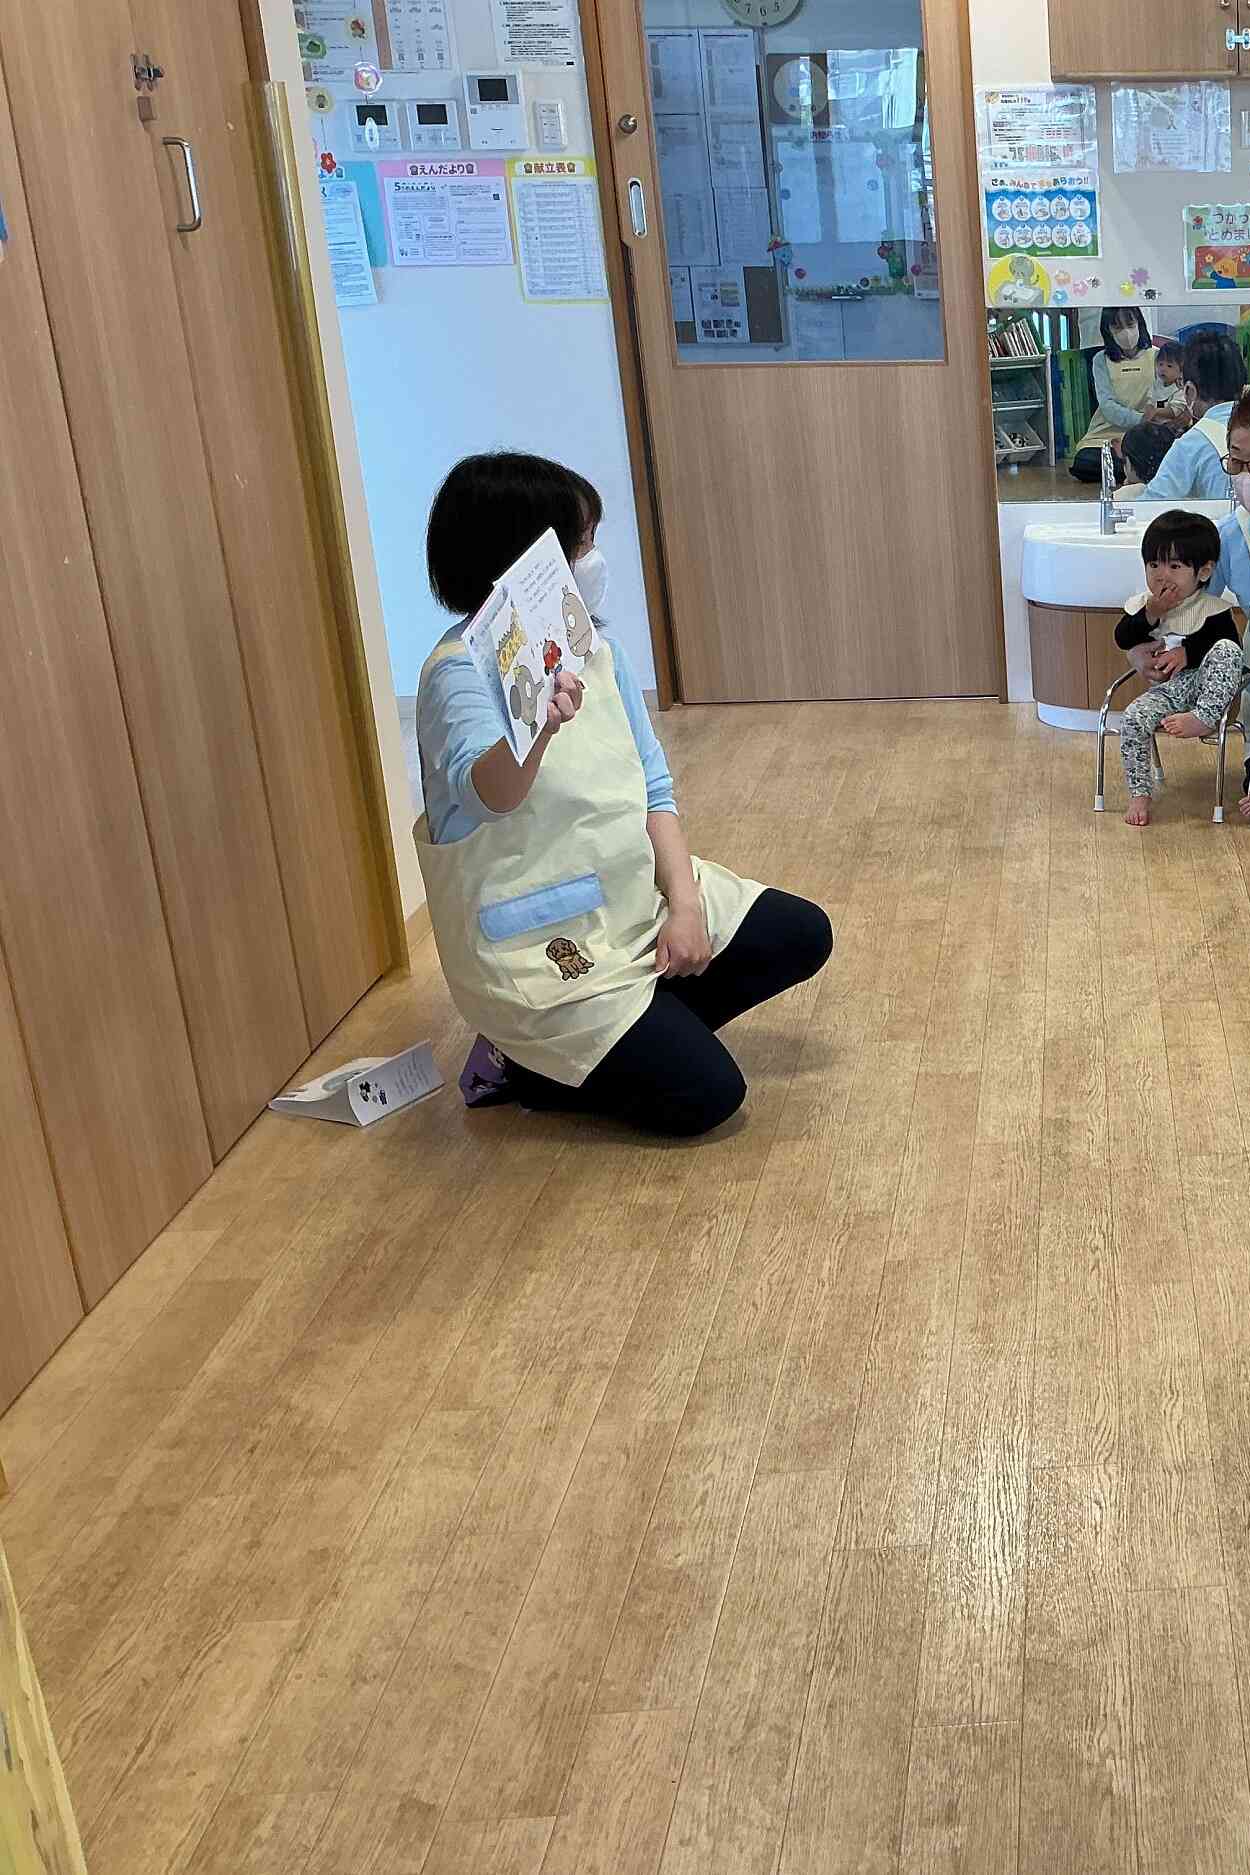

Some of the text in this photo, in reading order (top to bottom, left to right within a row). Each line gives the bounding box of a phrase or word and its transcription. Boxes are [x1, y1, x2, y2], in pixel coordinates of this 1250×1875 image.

[419, 164, 467, 176] えんだより
